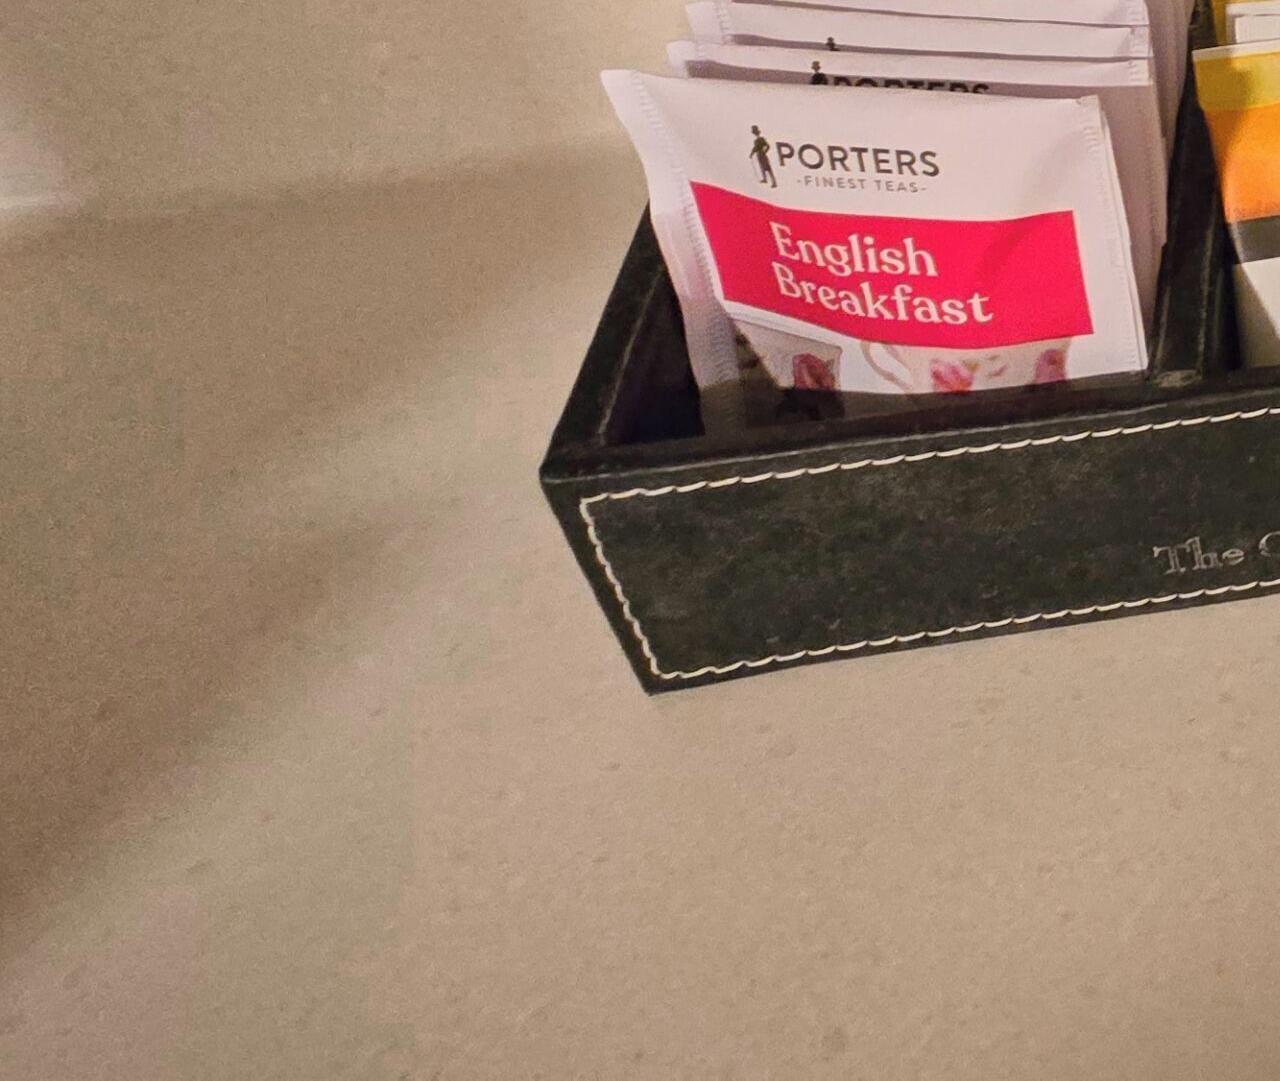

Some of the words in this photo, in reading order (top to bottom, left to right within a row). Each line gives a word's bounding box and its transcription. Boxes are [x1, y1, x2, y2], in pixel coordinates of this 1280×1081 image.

[775, 141, 940, 177] PORTERS
[769, 220, 938, 277] English
[771, 260, 994, 325] Breakfast
[1152, 536, 1245, 575] The
